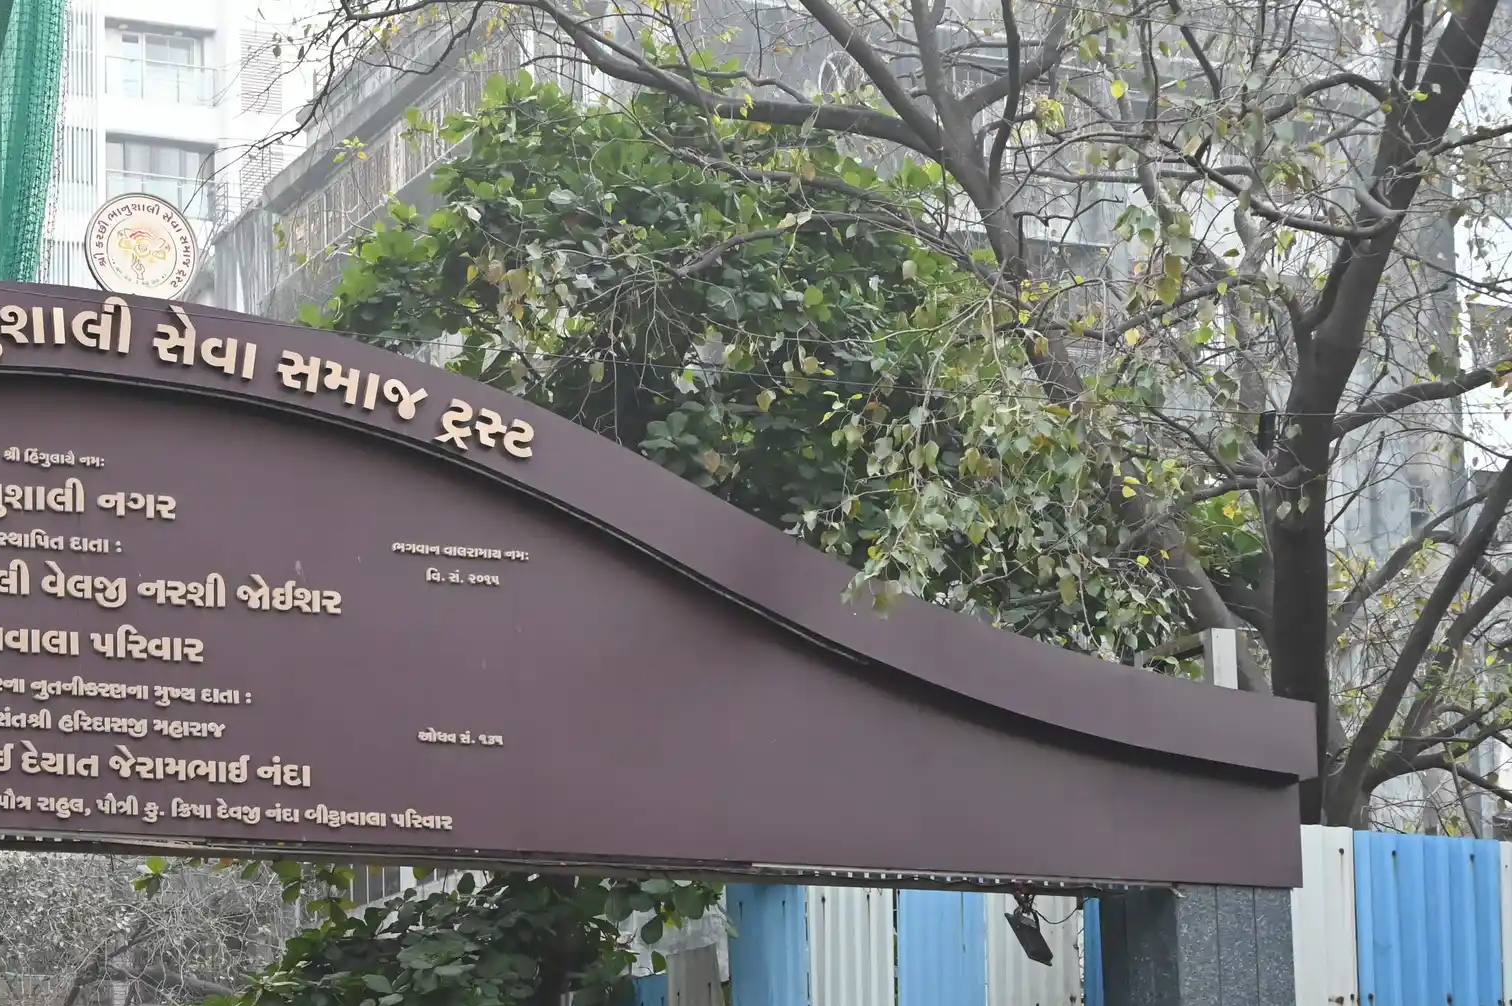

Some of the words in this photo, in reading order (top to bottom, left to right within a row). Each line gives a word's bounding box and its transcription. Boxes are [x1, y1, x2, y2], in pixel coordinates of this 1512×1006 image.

[108, 203, 161, 221] ભાનુશાલી
[162, 211, 182, 233] સેવા
[179, 235, 191, 268] સમાજ
[152, 305, 257, 379] સેવા
[277, 349, 429, 420] સમાજ
[434, 398, 535, 459] ટ્રસ્ટ
[3, 446, 20, 463] શ્રી
[97, 491, 177, 520] નગર
[69, 536, 110, 553] દાતા
[391, 542, 440, 555] ભગવાન
[41, 560, 128, 608] વેલજી
[137, 572, 226, 608] નરશી
[90, 624, 204, 663] પરિવાર
[153, 685, 195, 706] મુખ્ય
[200, 688, 240, 704] દાતા
[58, 709, 148, 738] હરિદાસજી
[153, 718, 226, 738] મહારાજ
[20, 740, 100, 777] દેયાત
[109, 744, 251, 783] જેરામભાઈ
[256, 755, 311, 787] નંદા
[37, 796, 91, 819] રાહુલ,
[216, 798, 261, 825] દેવજી
[264, 803, 300, 823] નંદા
[391, 808, 453, 831] પરિવાર
